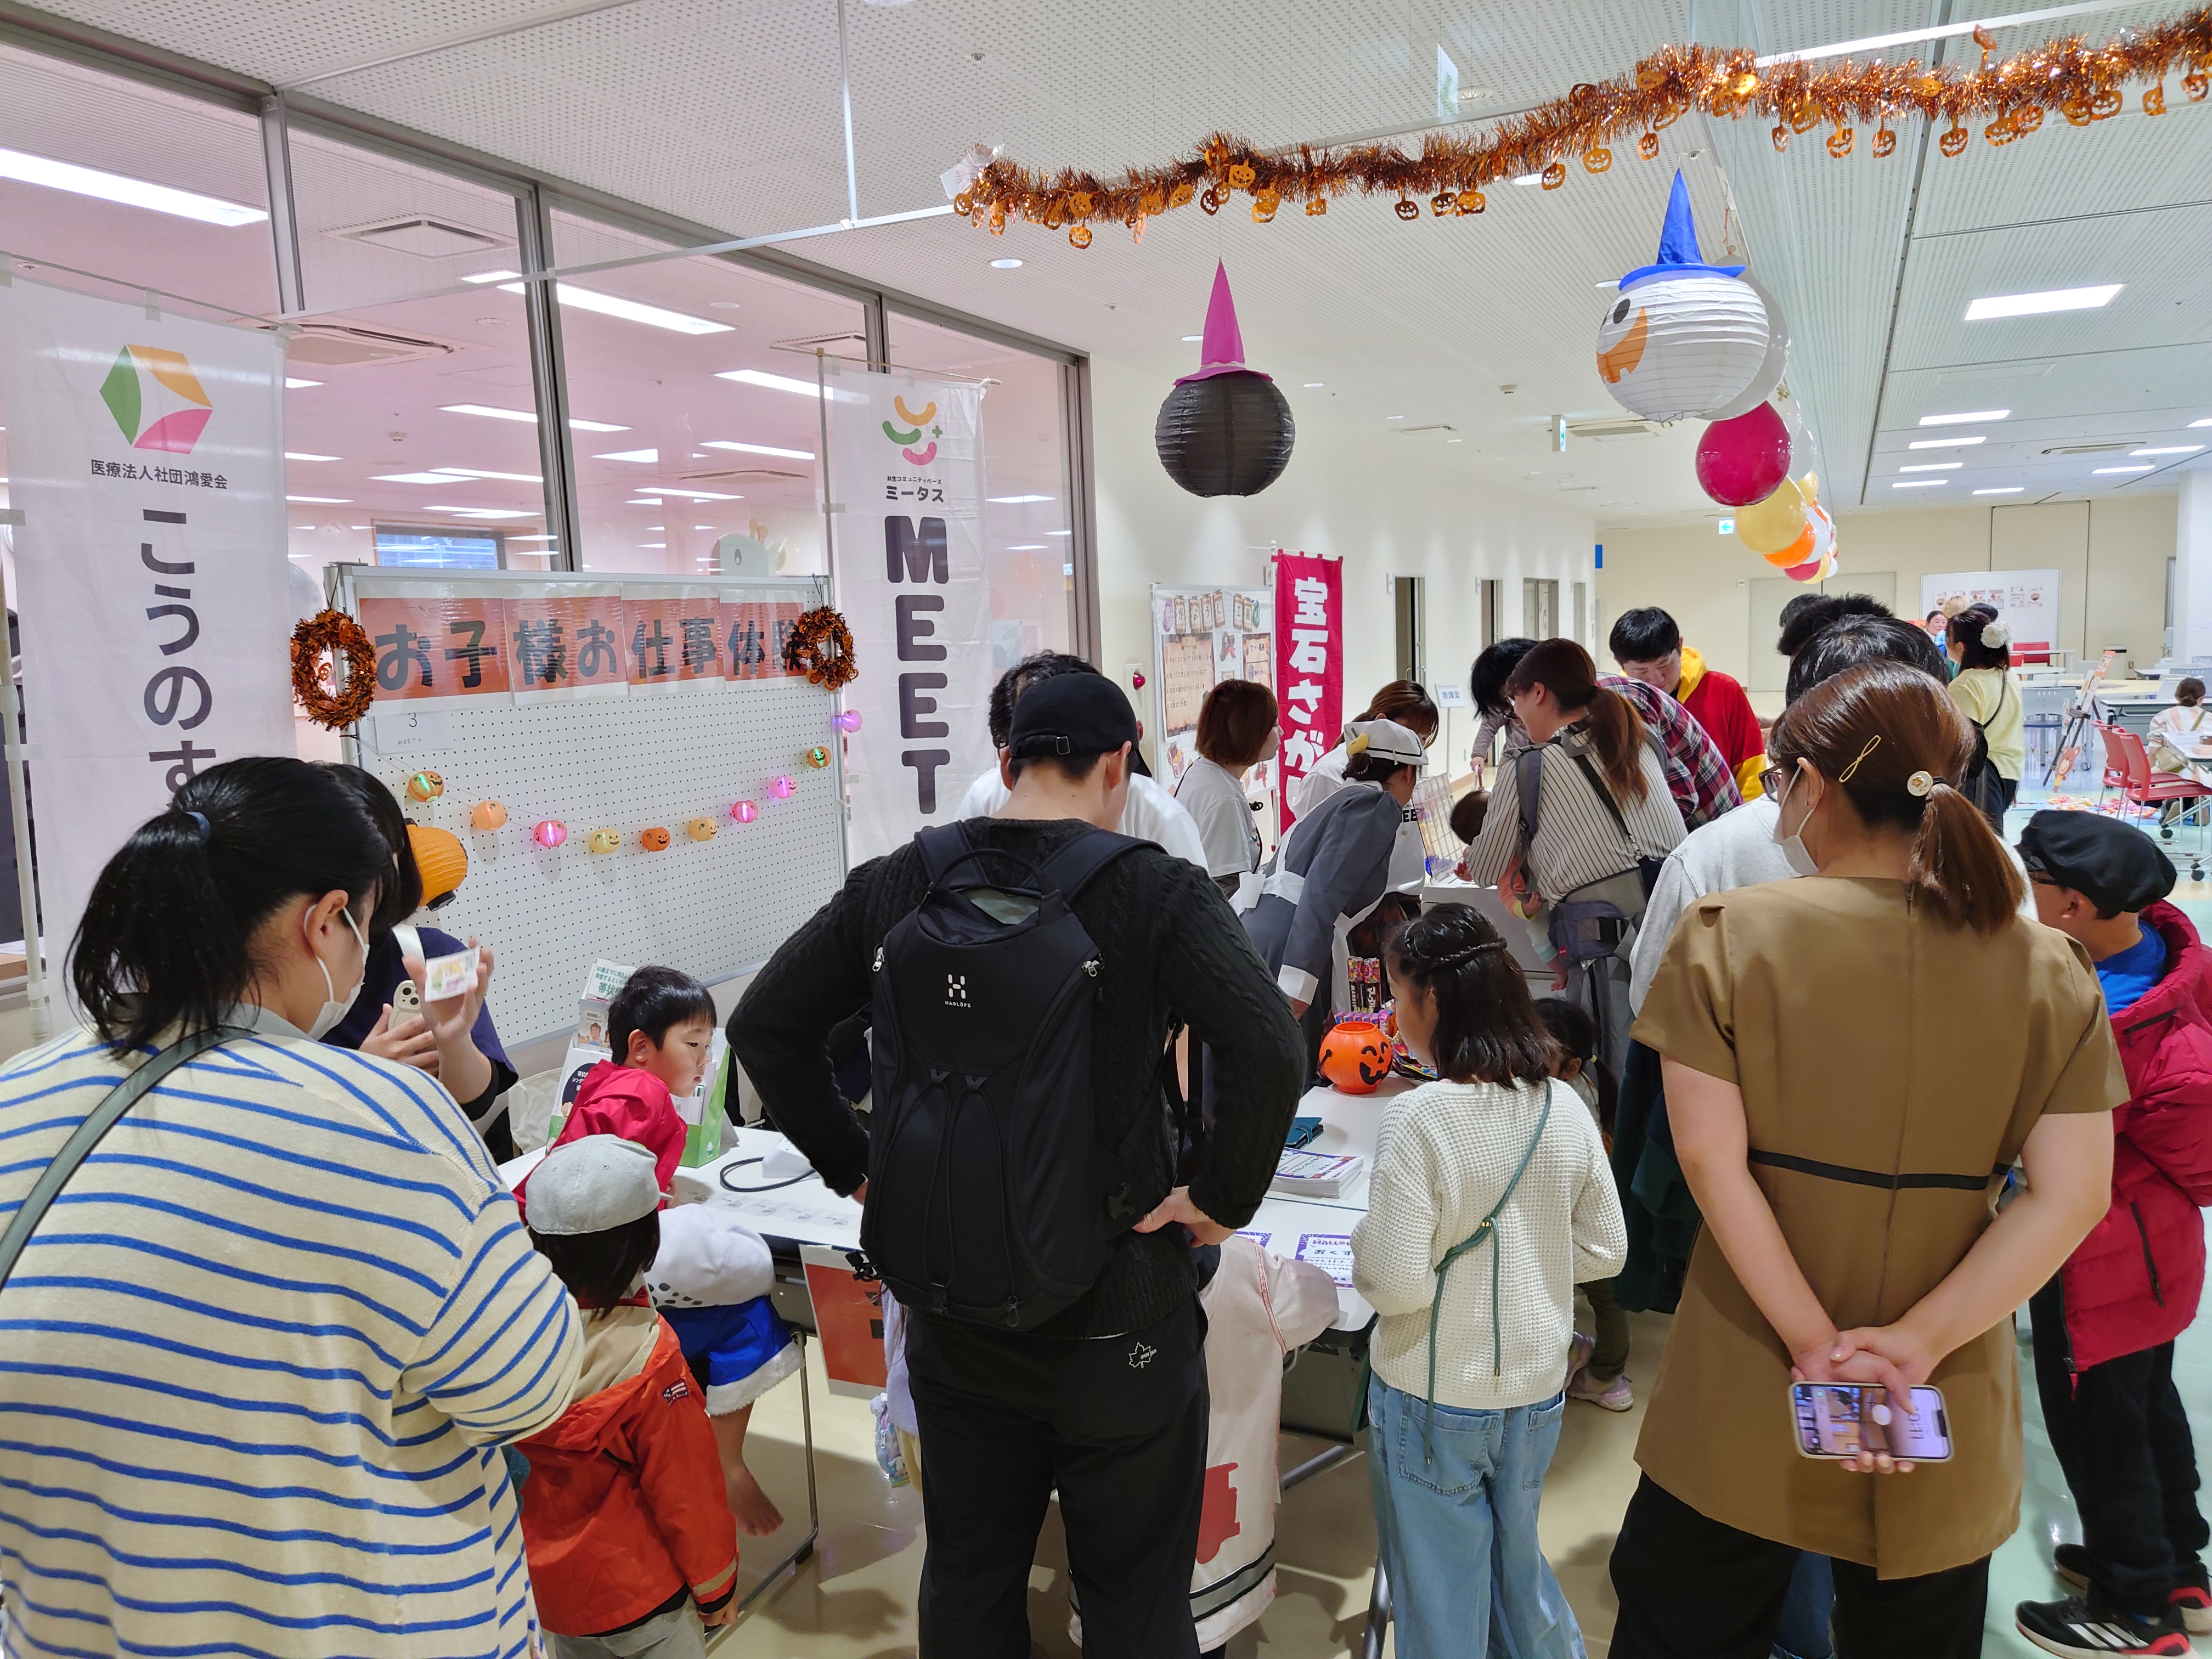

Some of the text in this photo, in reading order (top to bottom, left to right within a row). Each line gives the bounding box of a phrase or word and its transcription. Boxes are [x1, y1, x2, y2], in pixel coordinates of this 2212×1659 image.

[91, 459, 227, 489] 医療法人社団鴻愛会
[887, 476, 942, 484] 共生コミュニティベース
[886, 486, 944, 503] ミータス
[375, 616, 802, 691] お子様お仕事体験
[884, 516, 950, 814] MEET
[408, 712, 417, 727] 3
